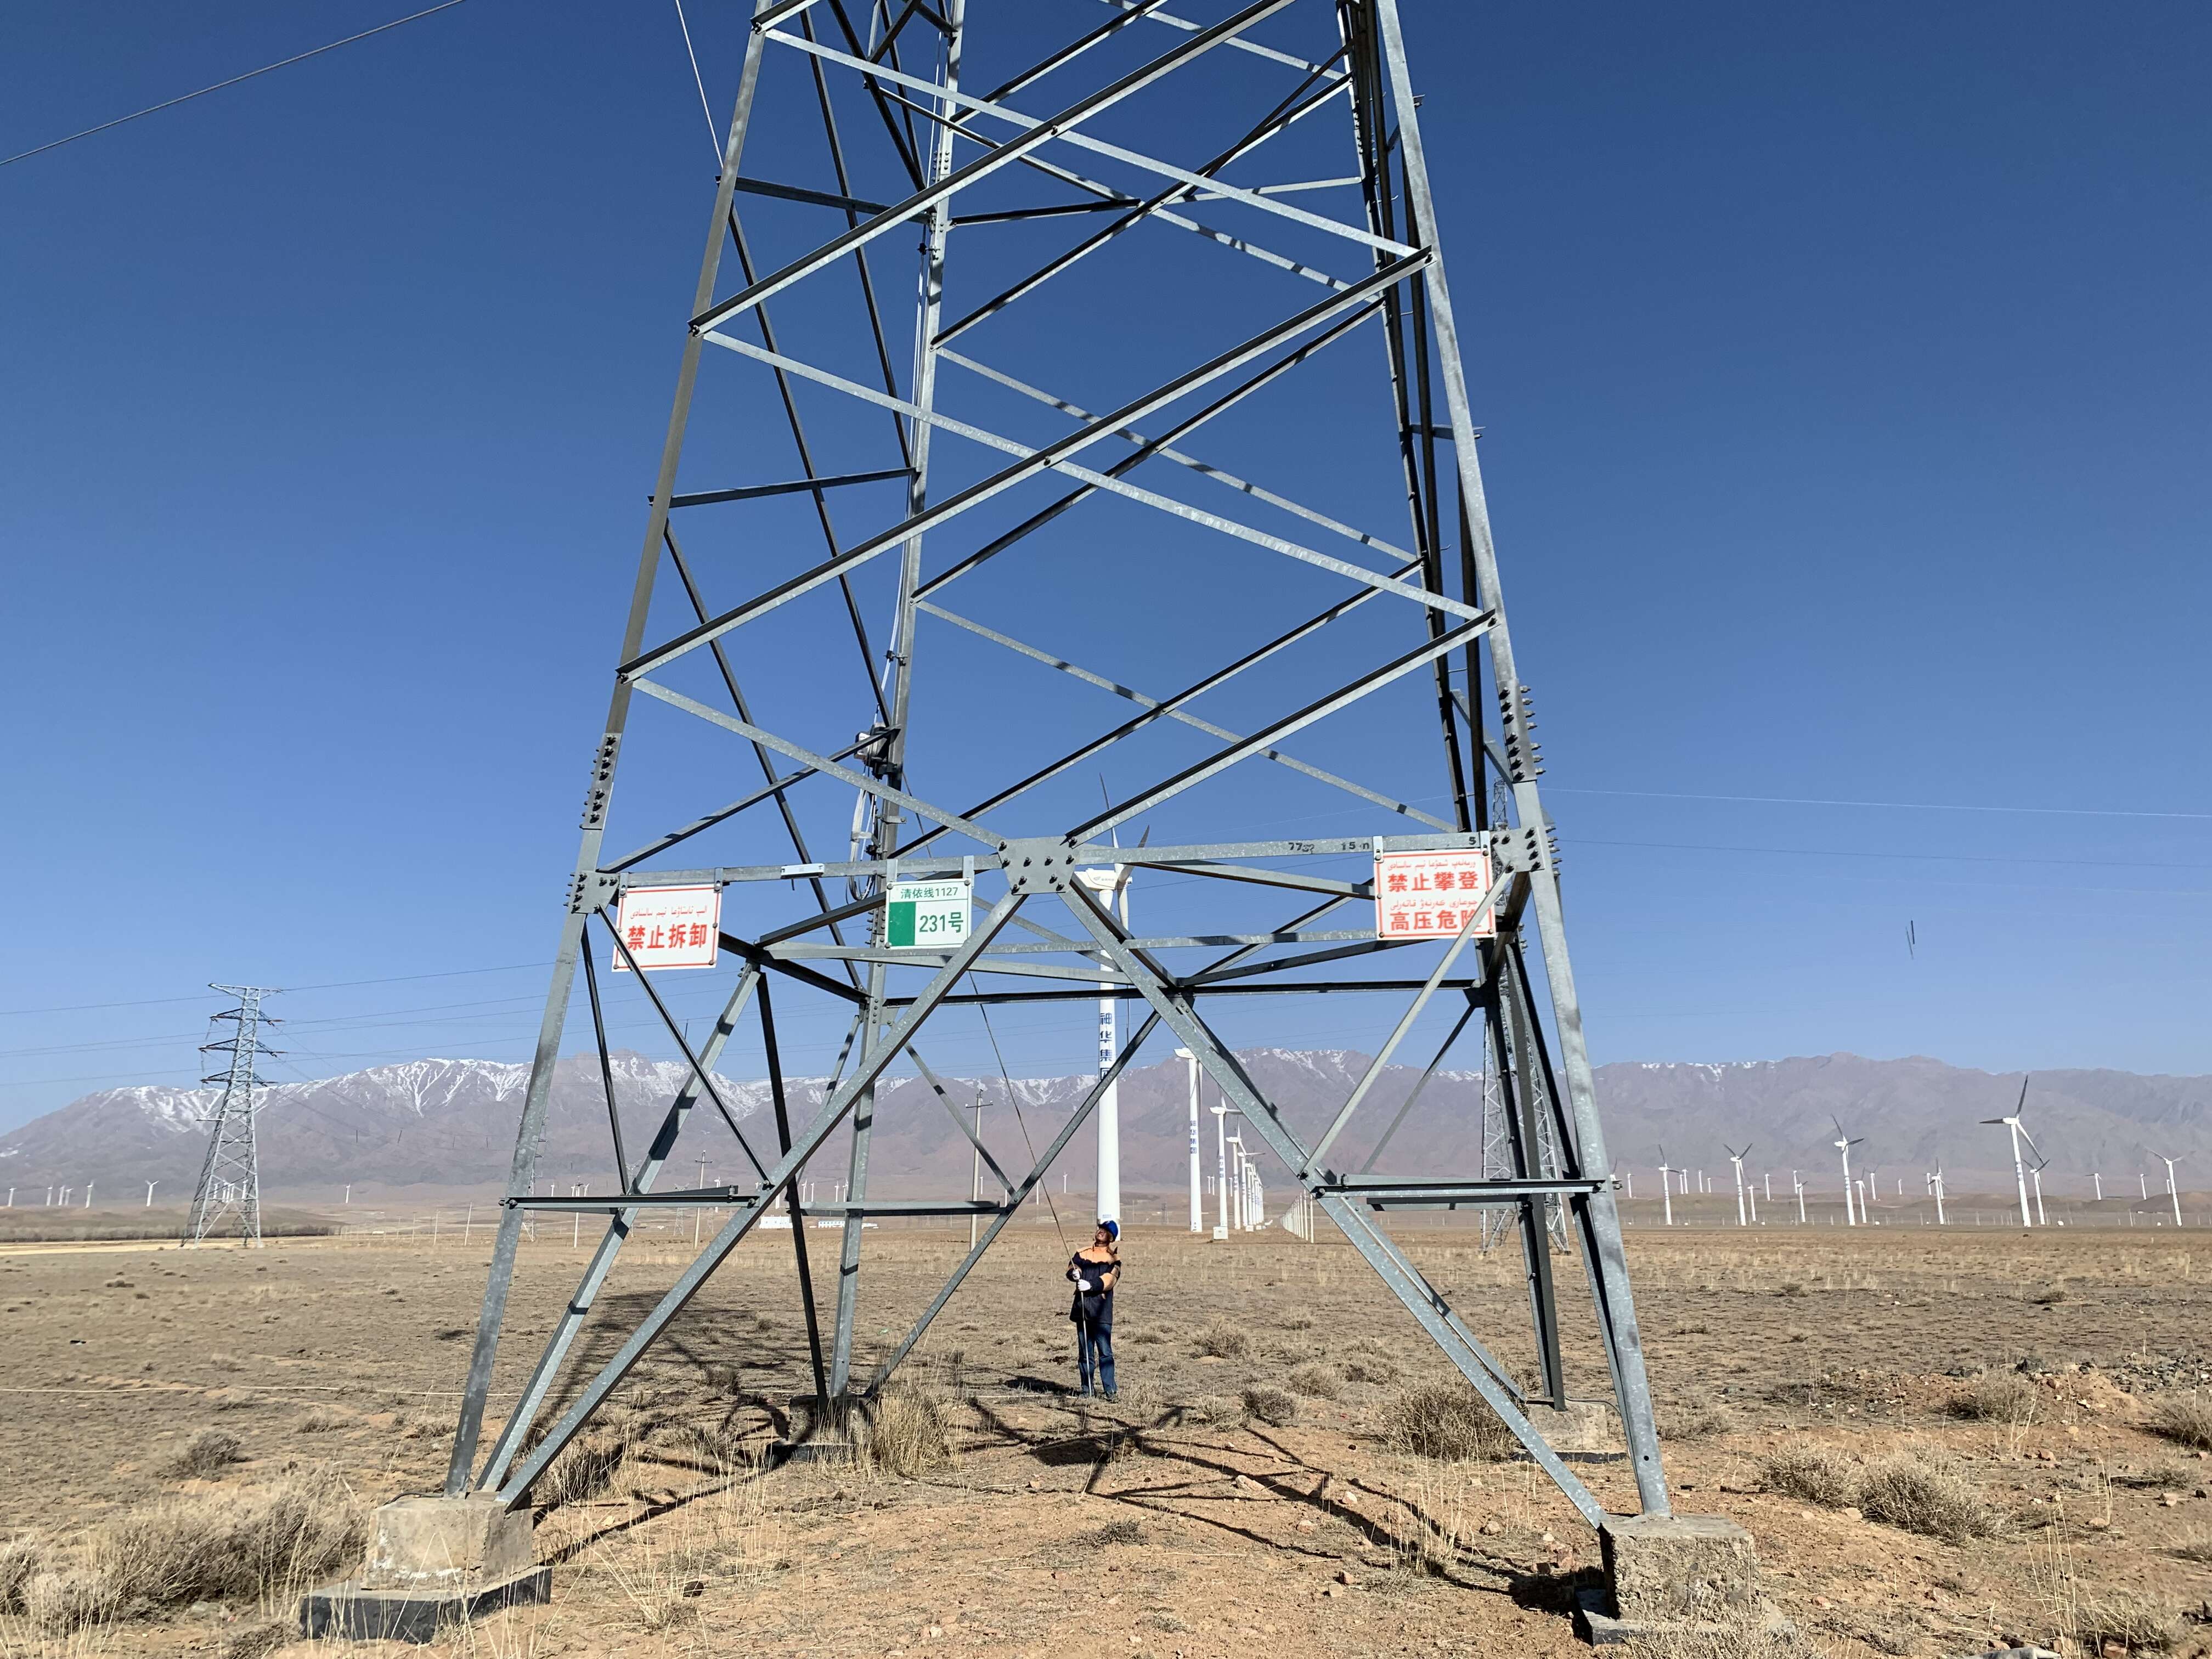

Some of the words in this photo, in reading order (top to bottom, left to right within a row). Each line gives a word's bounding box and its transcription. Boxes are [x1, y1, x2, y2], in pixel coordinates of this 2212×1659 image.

[1387, 870, 1479, 893] 禁止攀登
[900, 887, 958, 899] 清依线1127
[919, 911, 964, 933] 231号
[627, 922, 708, 951] 禁止拆卸
